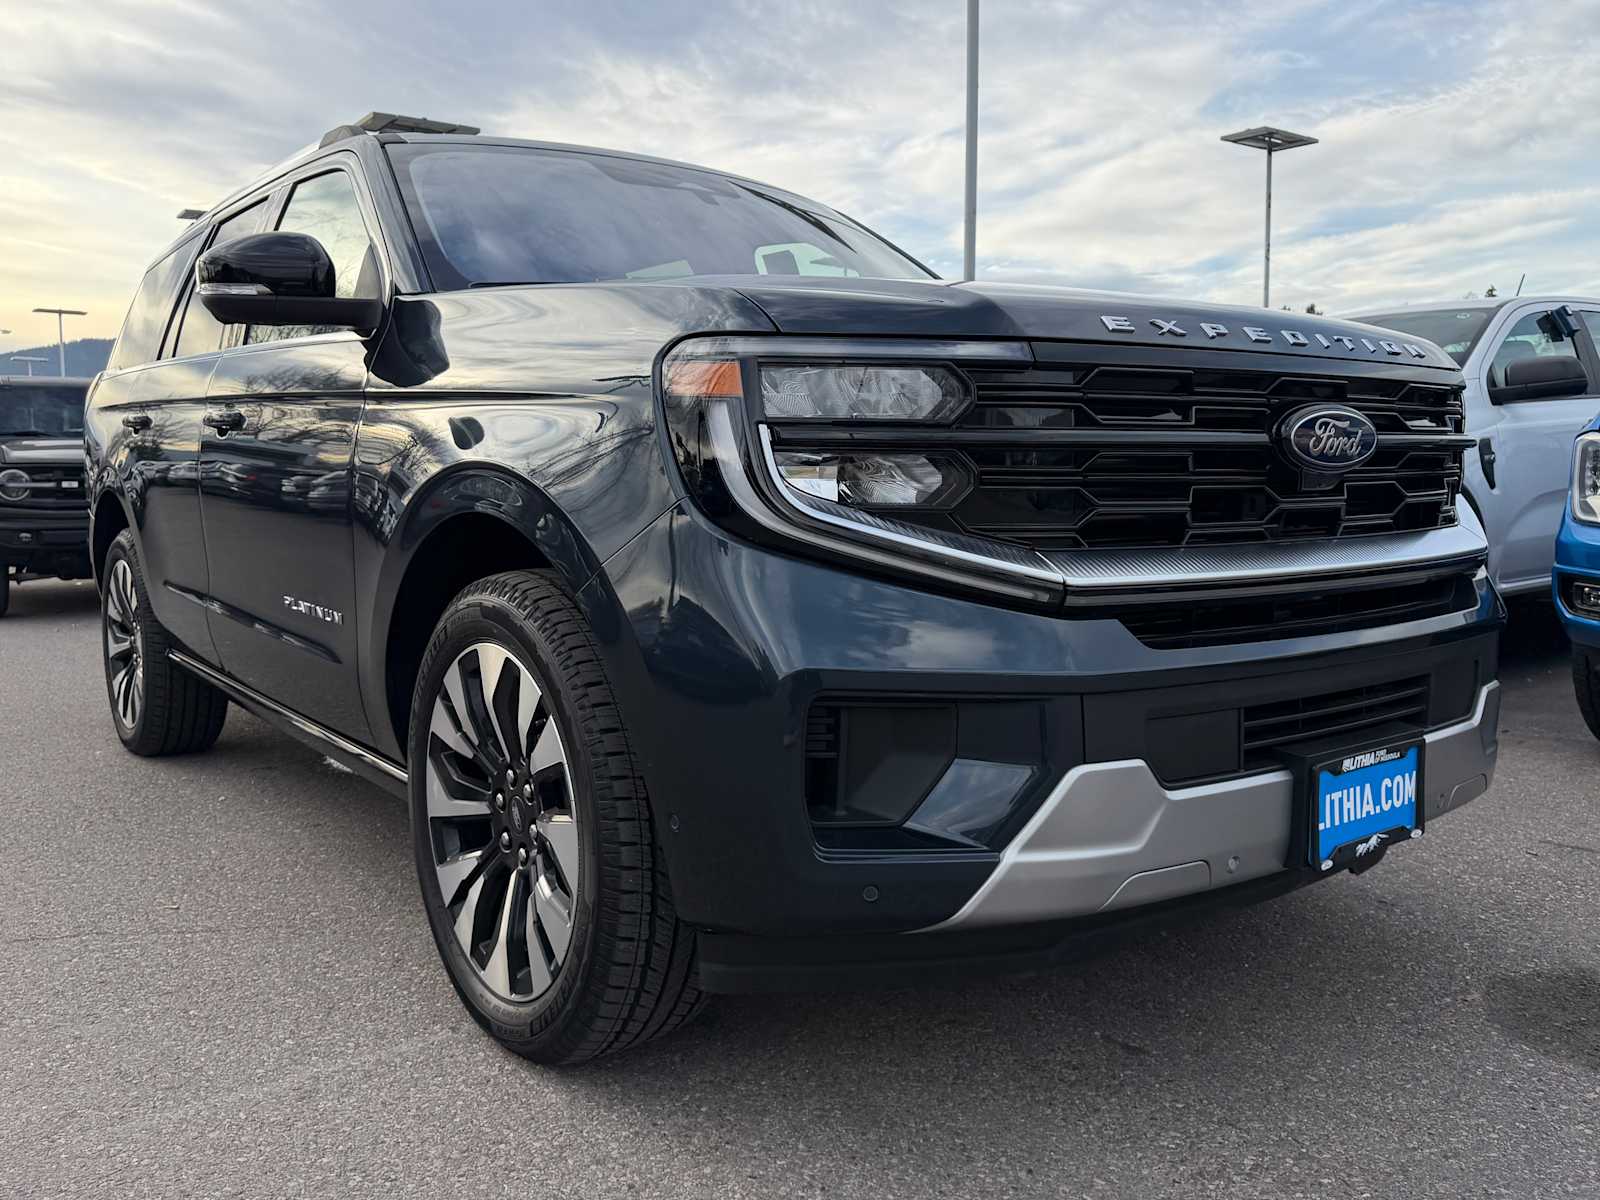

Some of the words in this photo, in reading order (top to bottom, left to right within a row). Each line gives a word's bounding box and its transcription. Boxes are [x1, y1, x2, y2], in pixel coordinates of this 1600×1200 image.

[1100, 315, 1426, 358] EXPEDITION
[1309, 418, 1362, 456] Ford
[283, 595, 342, 624] PLATINUM
